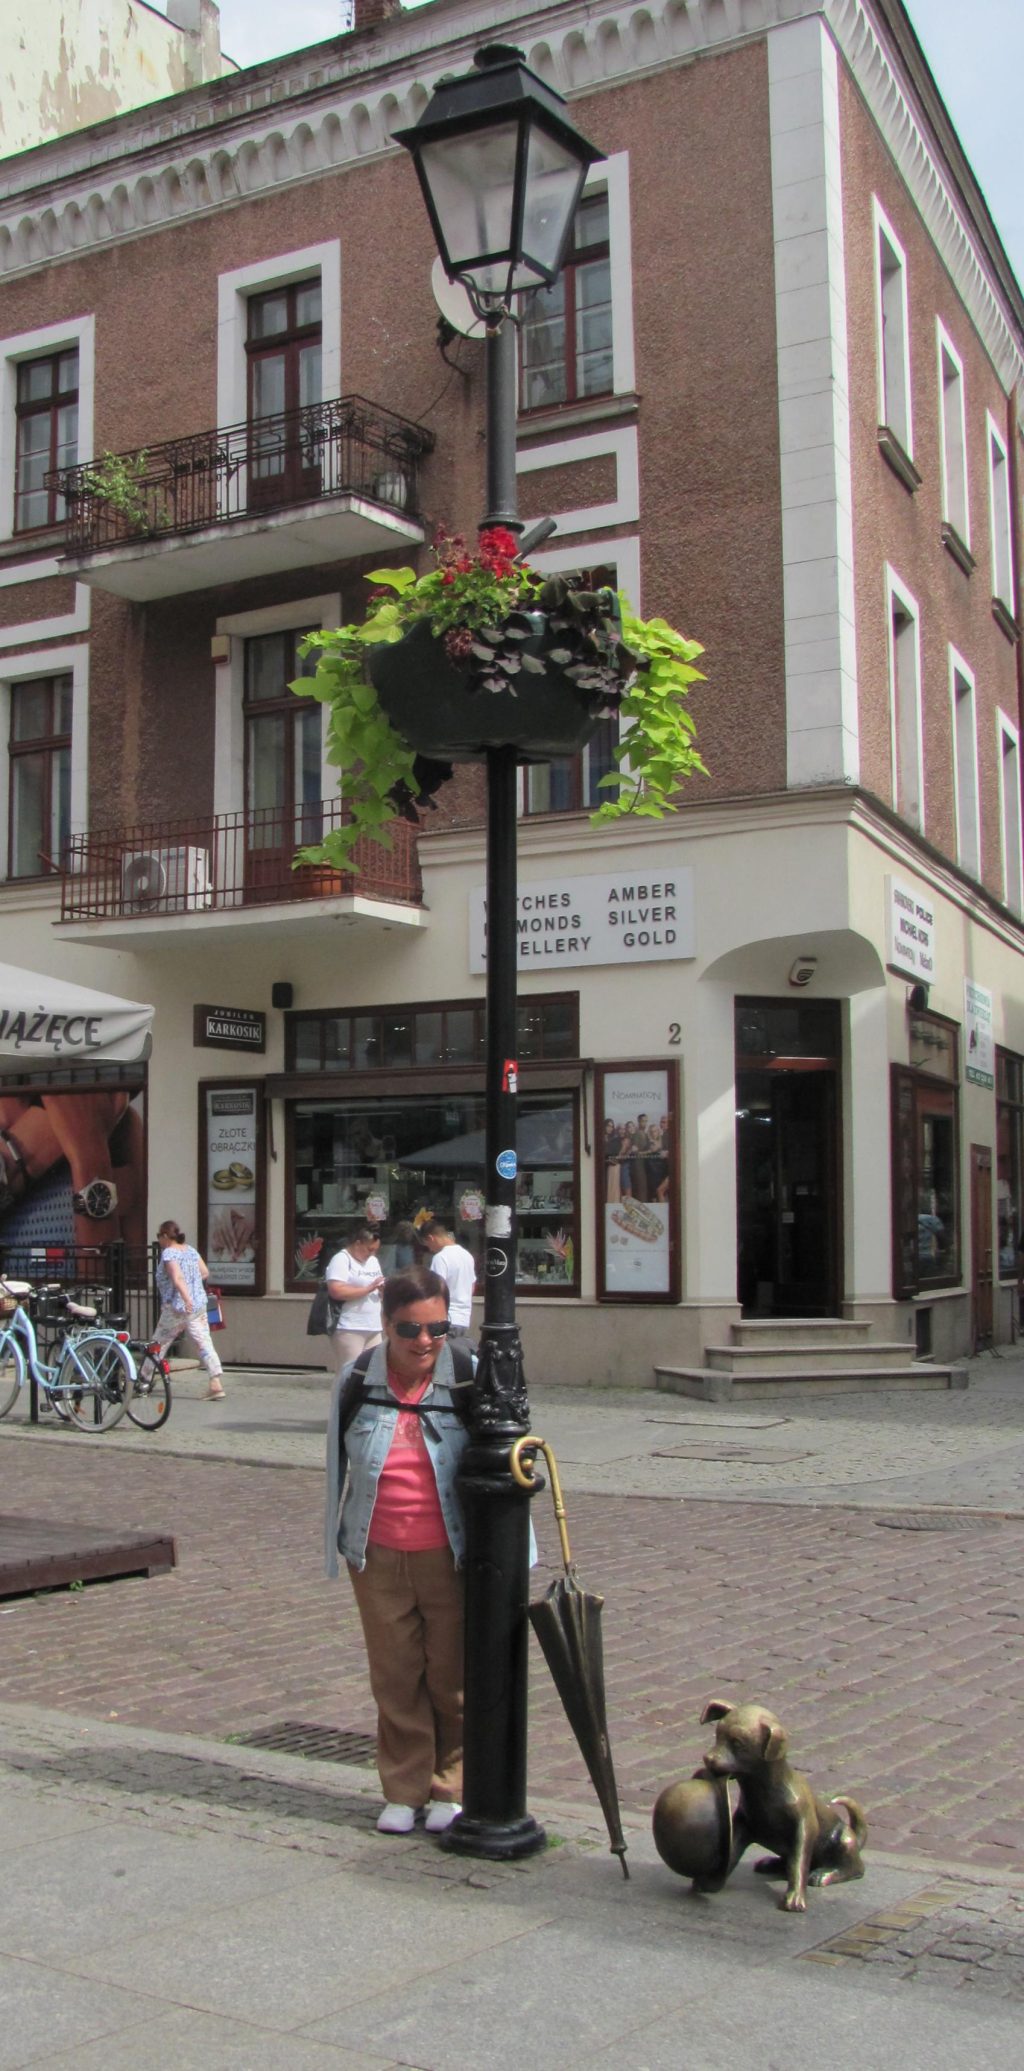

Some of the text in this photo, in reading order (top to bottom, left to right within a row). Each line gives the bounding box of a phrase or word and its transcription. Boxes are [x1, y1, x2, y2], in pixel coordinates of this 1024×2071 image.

[484, 883, 676, 914] CHES AMBER
[608, 906, 676, 926] SILVER
[623, 929, 676, 947] GOLD
[208, 1021, 260, 1039] KARKOSIK
[668, 1022, 682, 1045] 2
[219, 1128, 247, 1138] ZŁOTE
